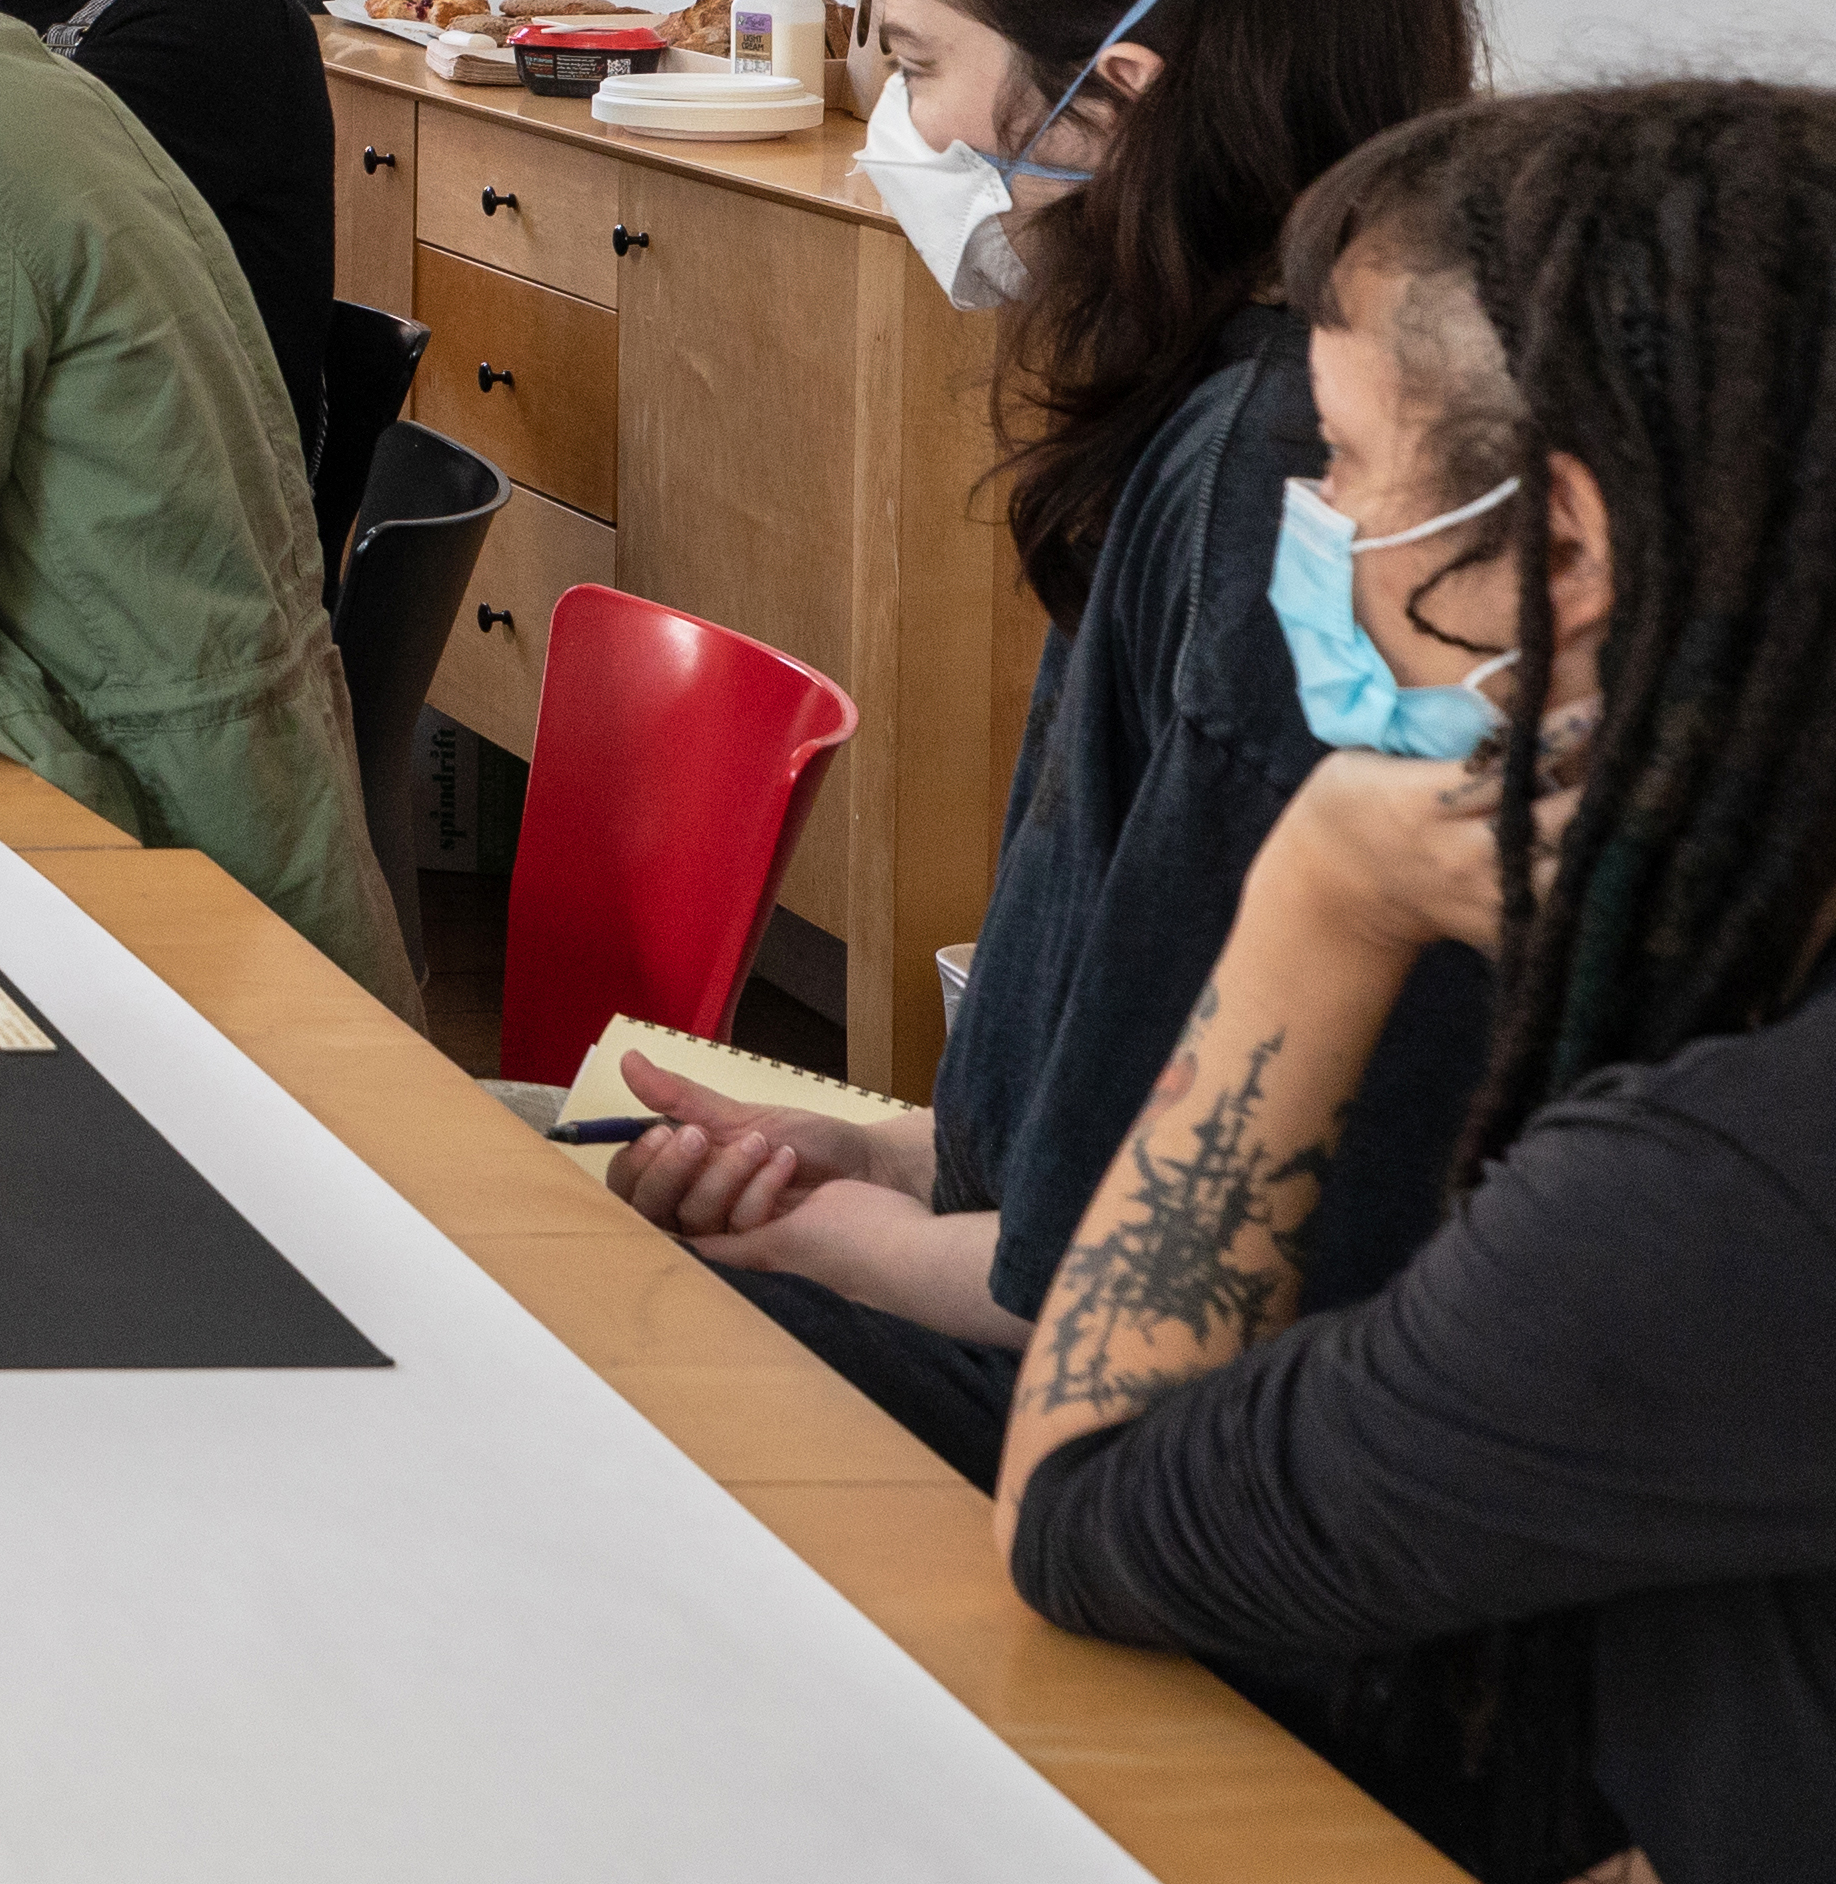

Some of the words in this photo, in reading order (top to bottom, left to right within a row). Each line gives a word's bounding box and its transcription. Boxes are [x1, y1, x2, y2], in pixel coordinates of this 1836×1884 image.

[743, 34, 763, 43] LIGHT
[741, 42, 764, 51] CREAM
[430, 728, 467, 851] spindrift
